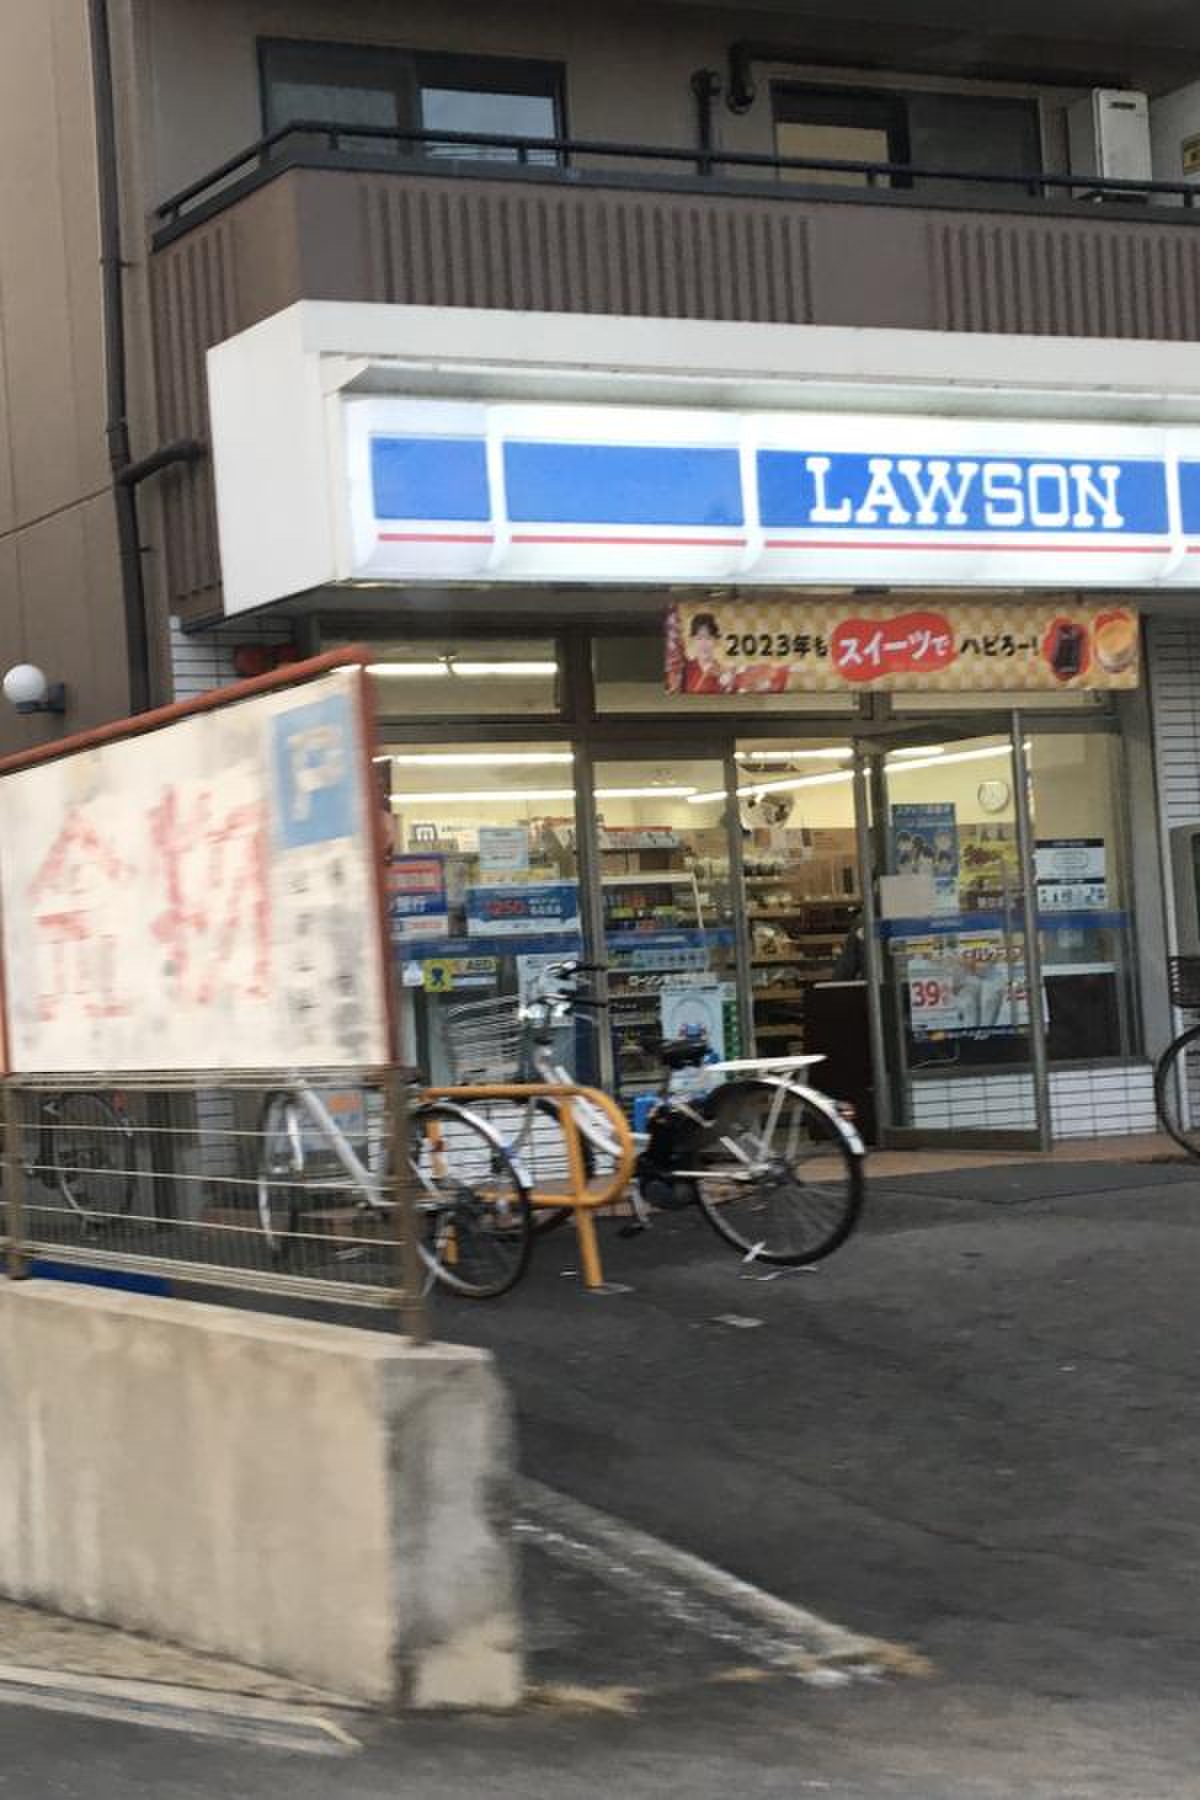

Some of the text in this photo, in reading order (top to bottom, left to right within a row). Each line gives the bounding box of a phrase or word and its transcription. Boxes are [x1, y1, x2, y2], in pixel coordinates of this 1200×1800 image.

[806, 457, 1124, 528] LAWSON
[725, 633, 828, 657] 2023年も
[838, 630, 949, 666] スイーツで
[288, 727, 345, 821] P
